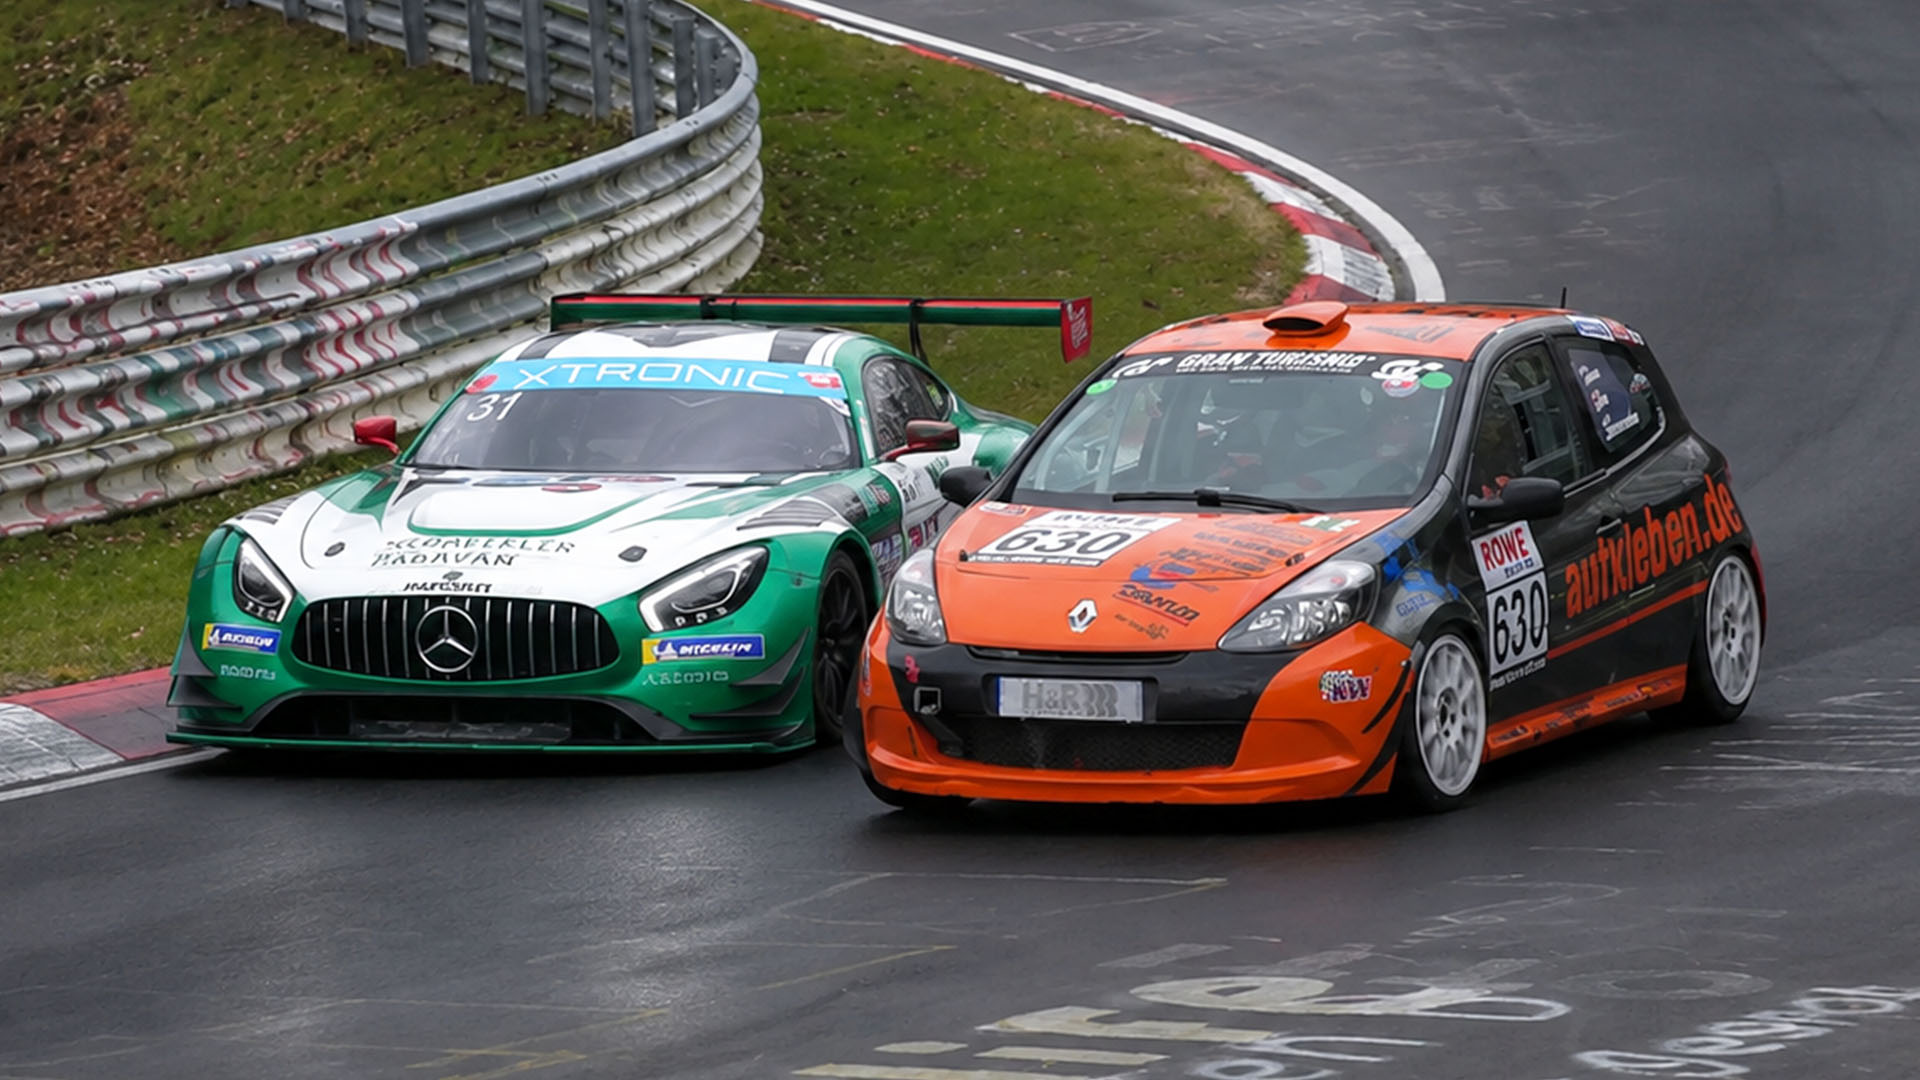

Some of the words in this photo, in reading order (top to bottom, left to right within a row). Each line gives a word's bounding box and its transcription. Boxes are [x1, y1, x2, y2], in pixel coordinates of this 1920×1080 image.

[1177, 352, 1252, 367] GRAN
[513, 362, 789, 394] XTRONIC
[466, 390, 523, 422] 31
[995, 529, 1132, 555] 630
[1479, 527, 1530, 572] ROWE
[1493, 580, 1546, 665] 630
